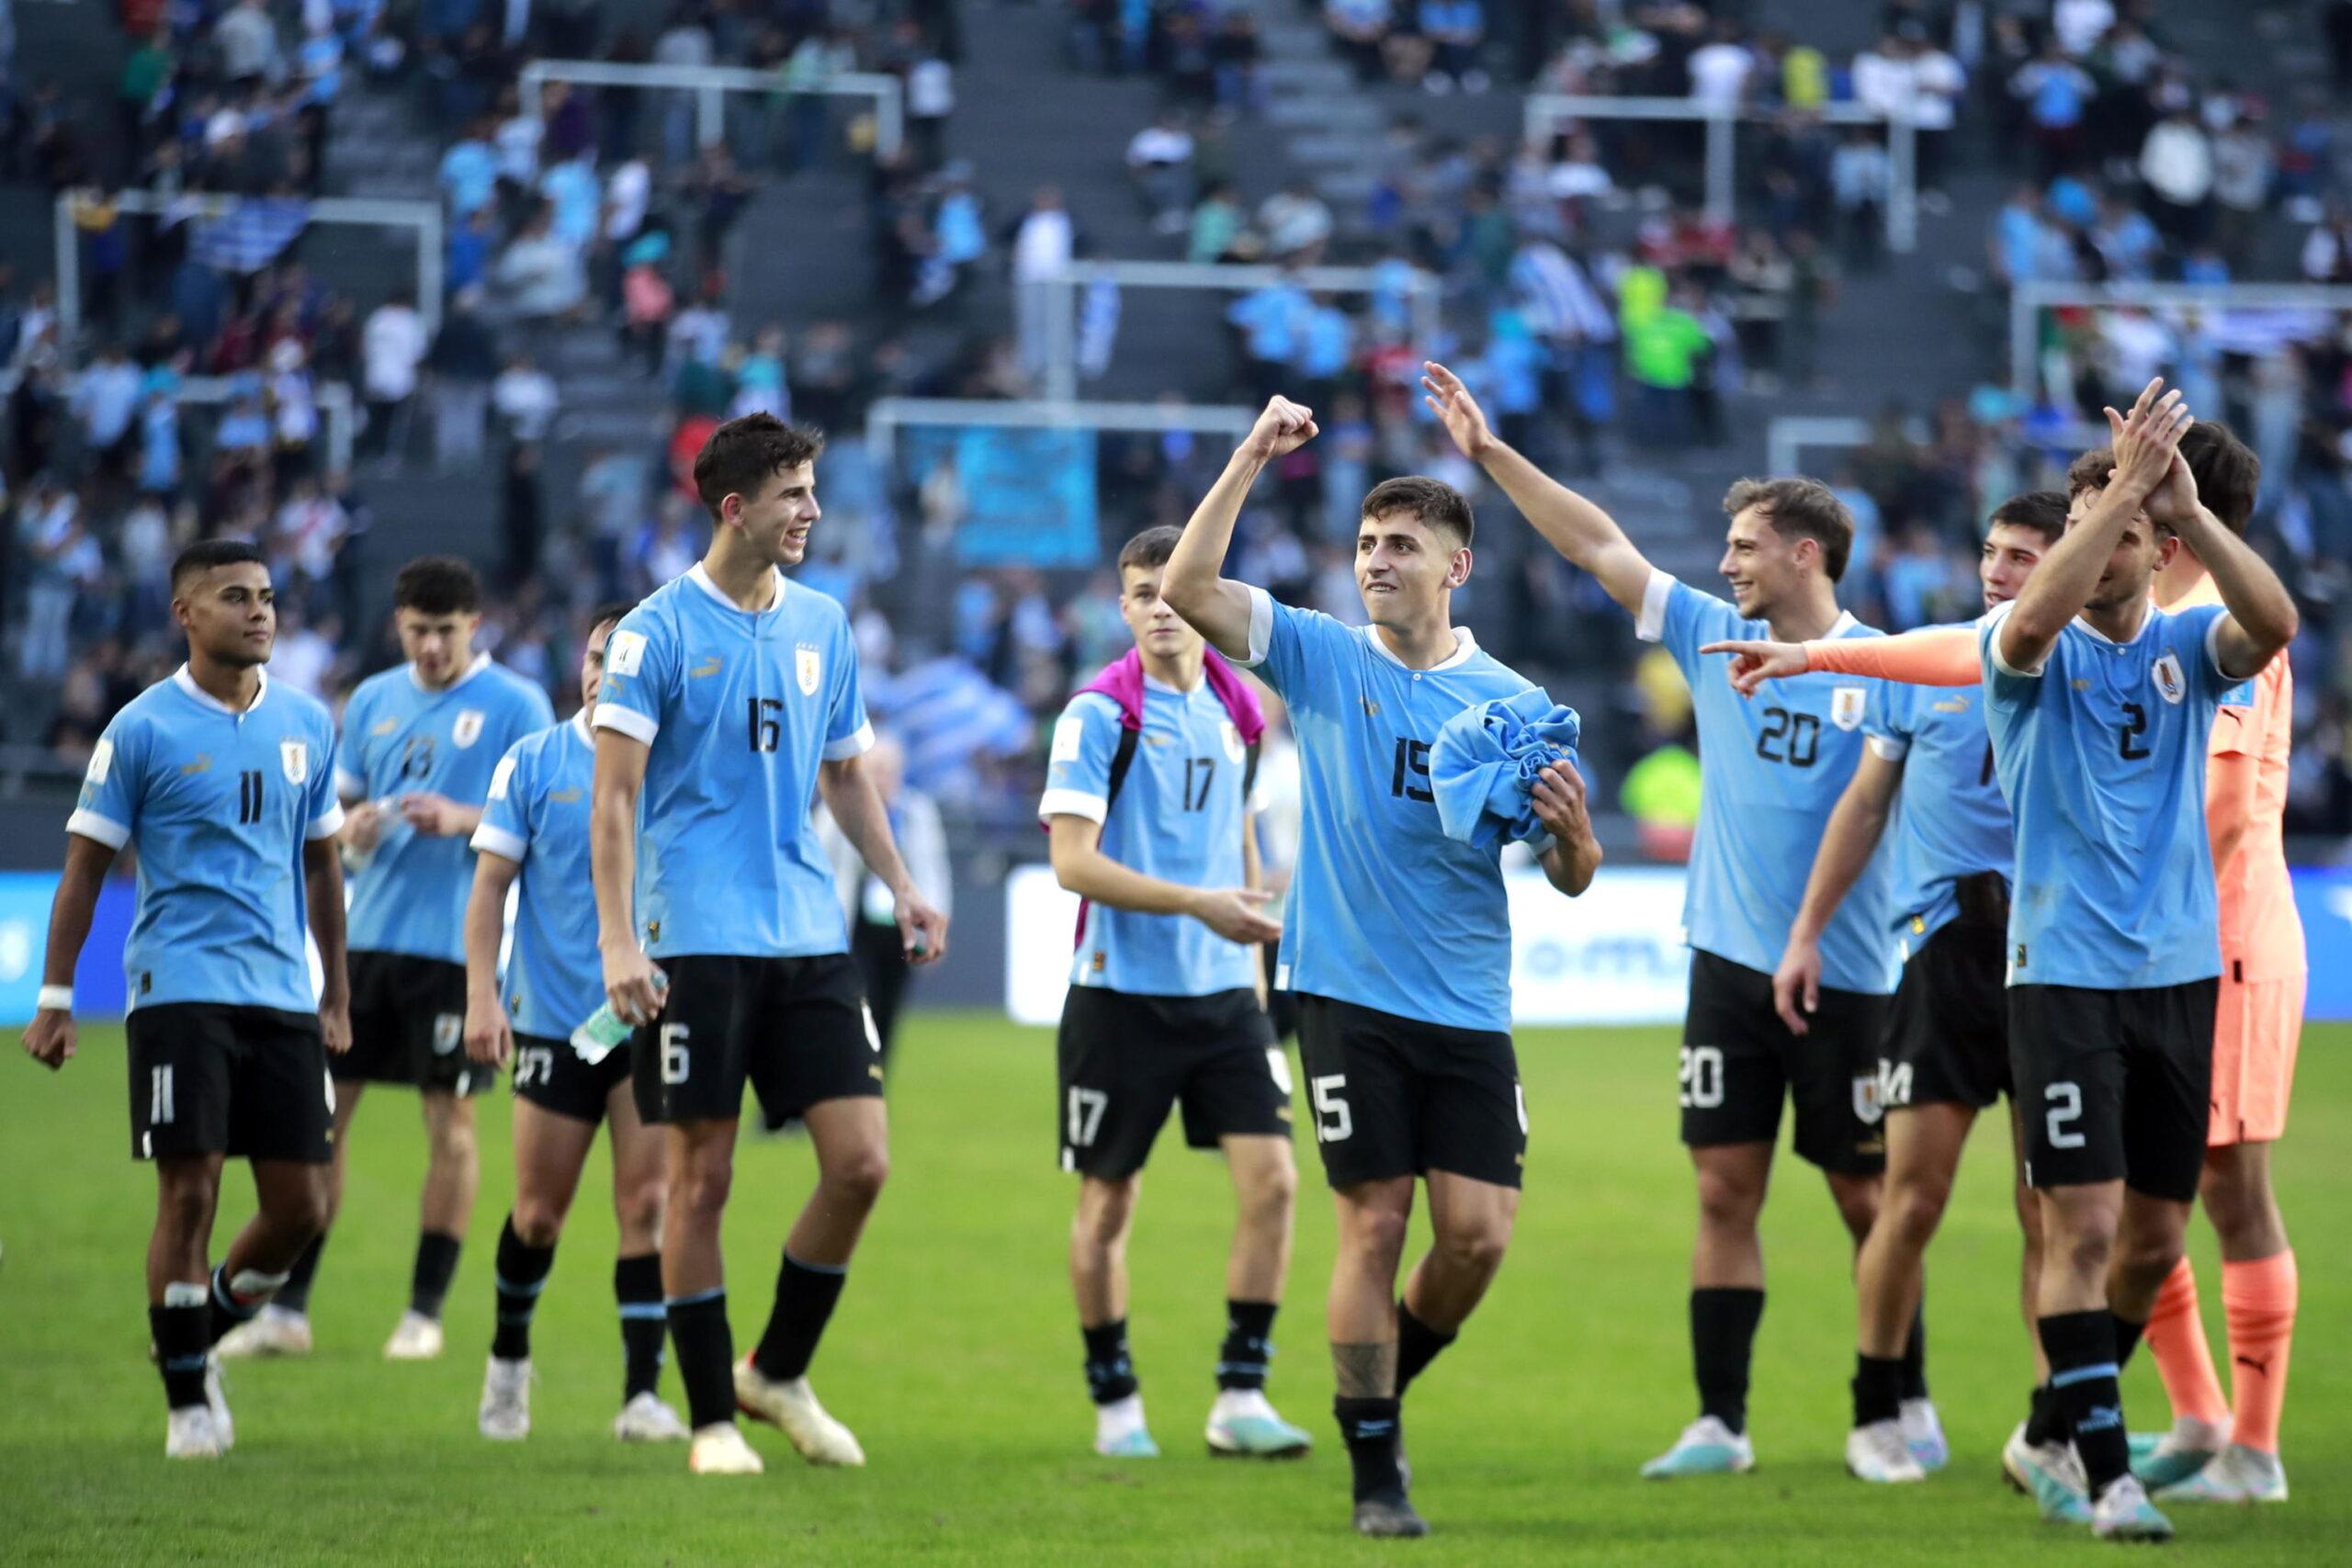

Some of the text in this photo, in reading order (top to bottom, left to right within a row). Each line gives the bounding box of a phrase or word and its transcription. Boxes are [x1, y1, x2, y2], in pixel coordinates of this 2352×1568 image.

[747, 696, 783, 753] 16
[1757, 706, 1821, 768] 20
[2120, 702, 2151, 761] 2
[239, 770, 264, 824] 11
[1183, 756, 1217, 813] 17
[1391, 736, 1435, 804] 15
[150, 1063, 175, 1125] 11
[1068, 1085, 1109, 1147] 17
[2044, 1080, 2086, 1149] 2
